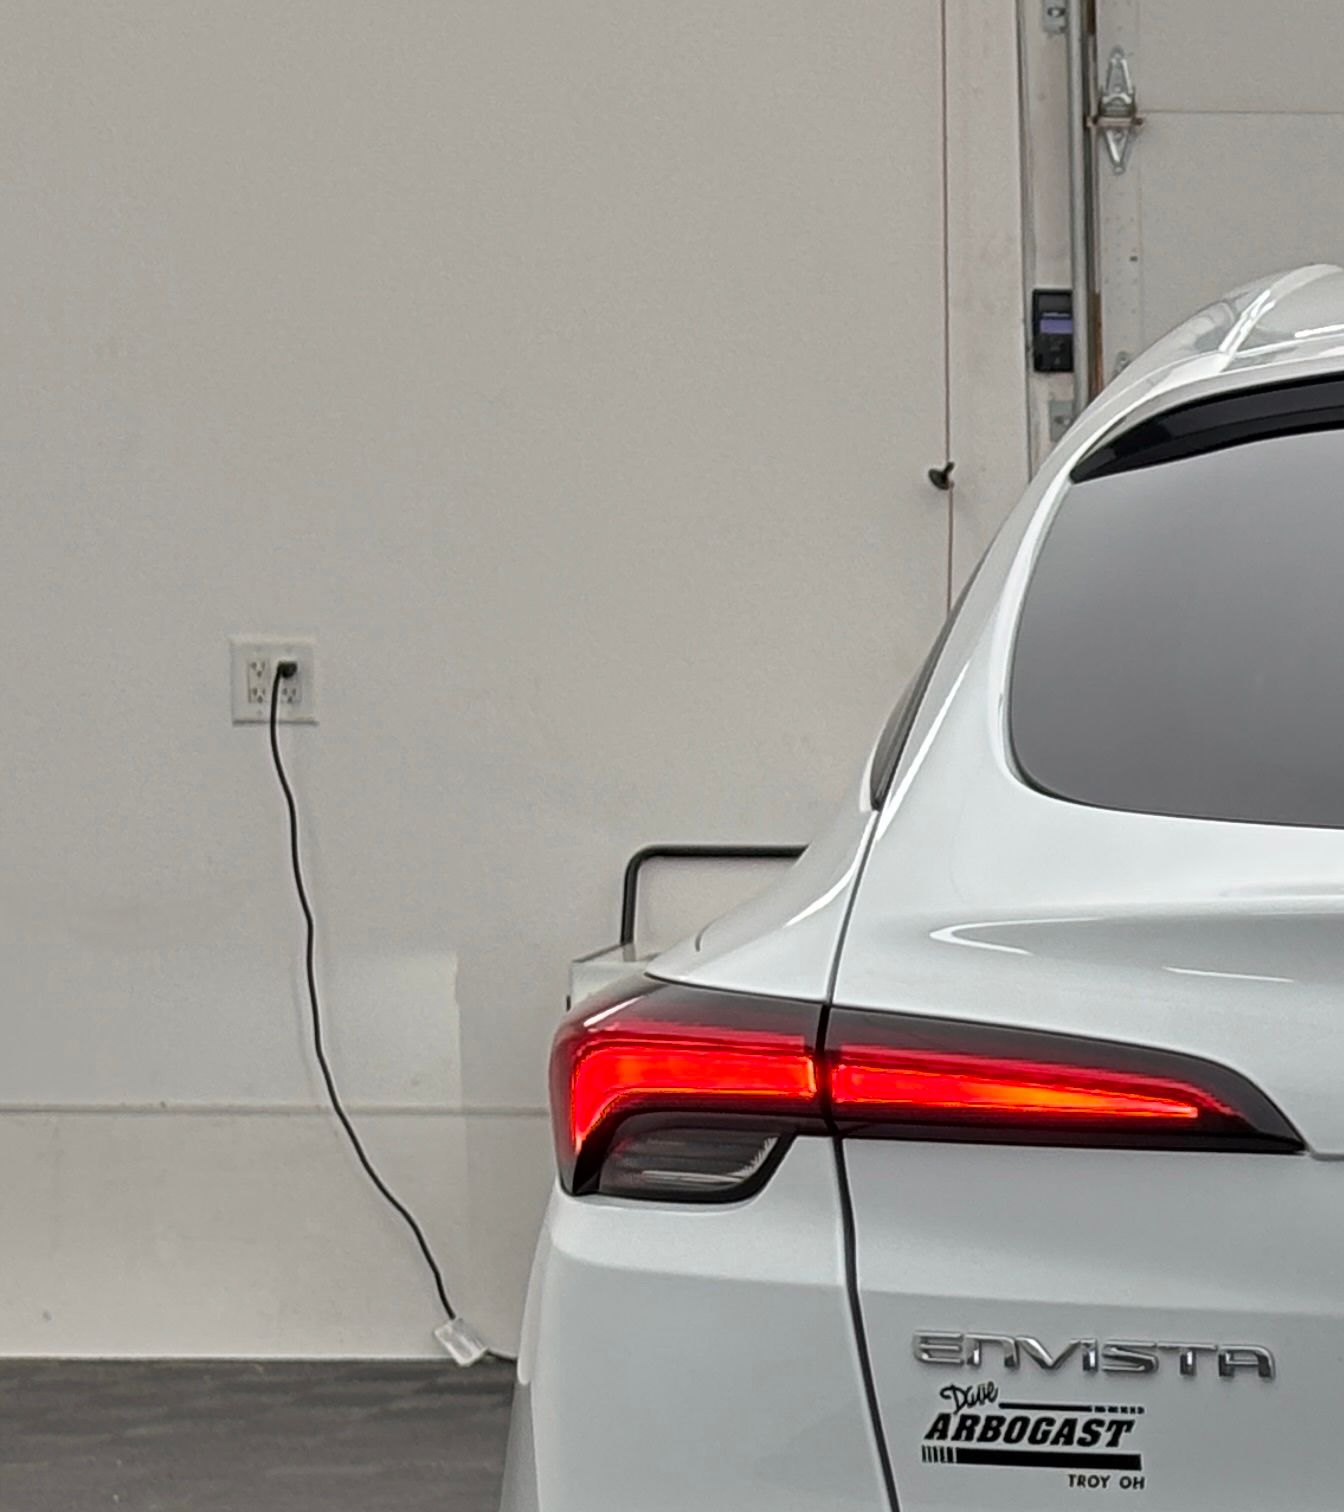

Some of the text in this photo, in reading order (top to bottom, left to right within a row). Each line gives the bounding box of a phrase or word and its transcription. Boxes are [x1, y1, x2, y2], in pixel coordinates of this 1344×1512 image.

[913, 1329, 1277, 1380] ENVISTA
[940, 1380, 999, 1414] Dave
[924, 1412, 1136, 1449] ARBOGAST
[1067, 1473, 1146, 1490] TROY OH
